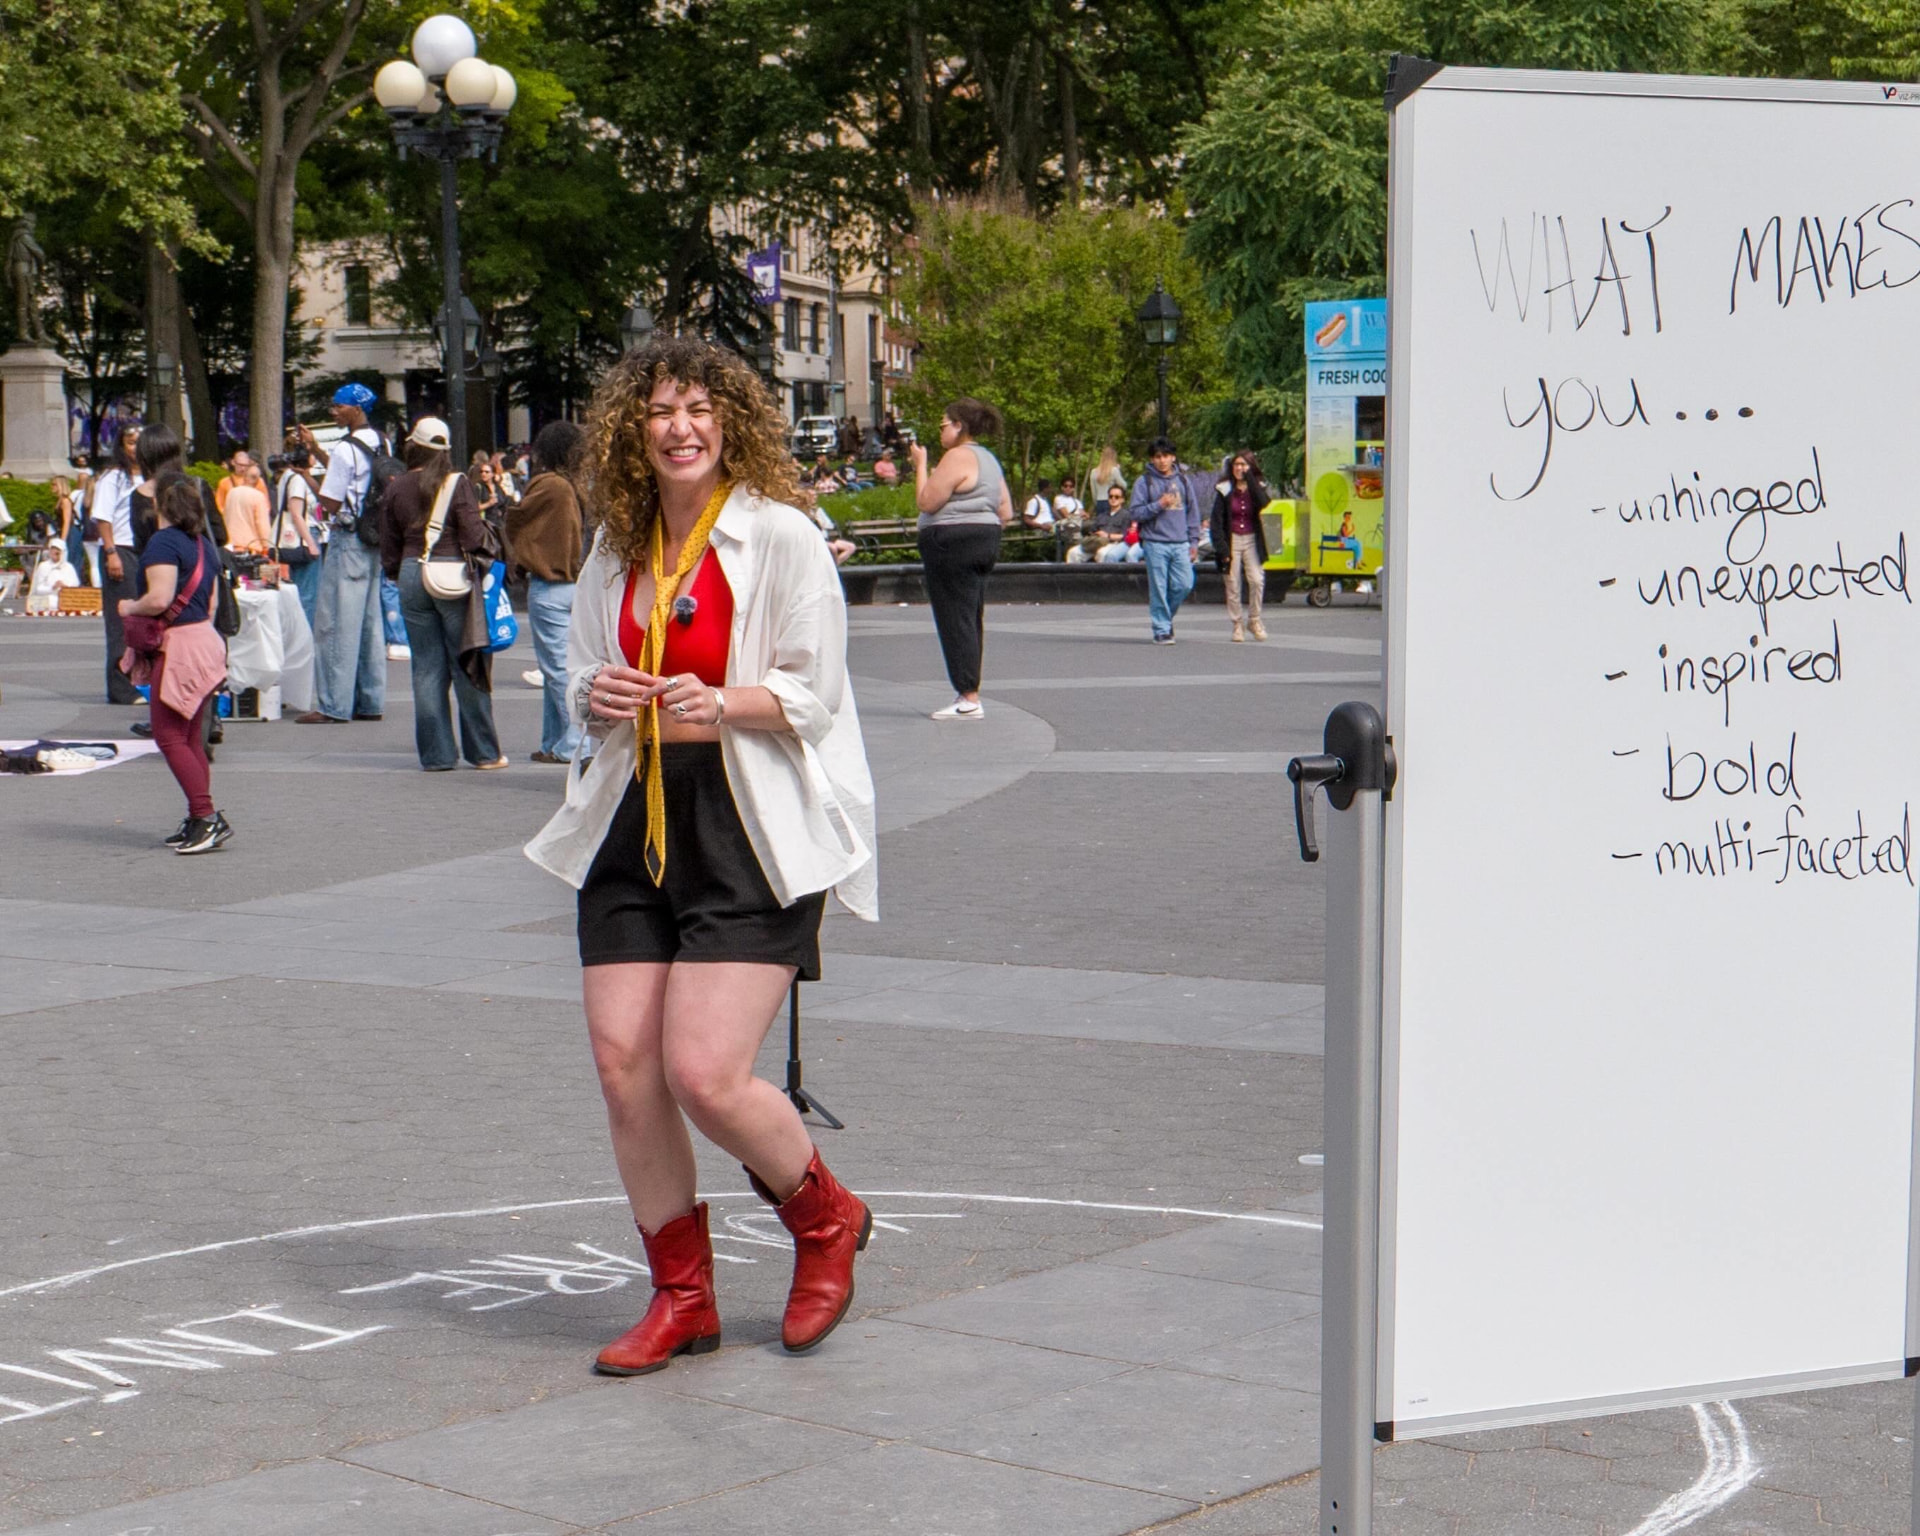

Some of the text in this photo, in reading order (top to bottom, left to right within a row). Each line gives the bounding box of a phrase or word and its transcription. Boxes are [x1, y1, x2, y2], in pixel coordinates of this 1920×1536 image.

[1469, 199, 1920, 336] WHAT MAKES
[1318, 370, 1359, 385] FRESH
[1619, 446, 1826, 566] unhinged
[1638, 531, 1912, 637] unexpected
[1658, 619, 1841, 727] inspired
[1662, 731, 1801, 802] bold
[1656, 801, 1914, 887] multi-faceted
